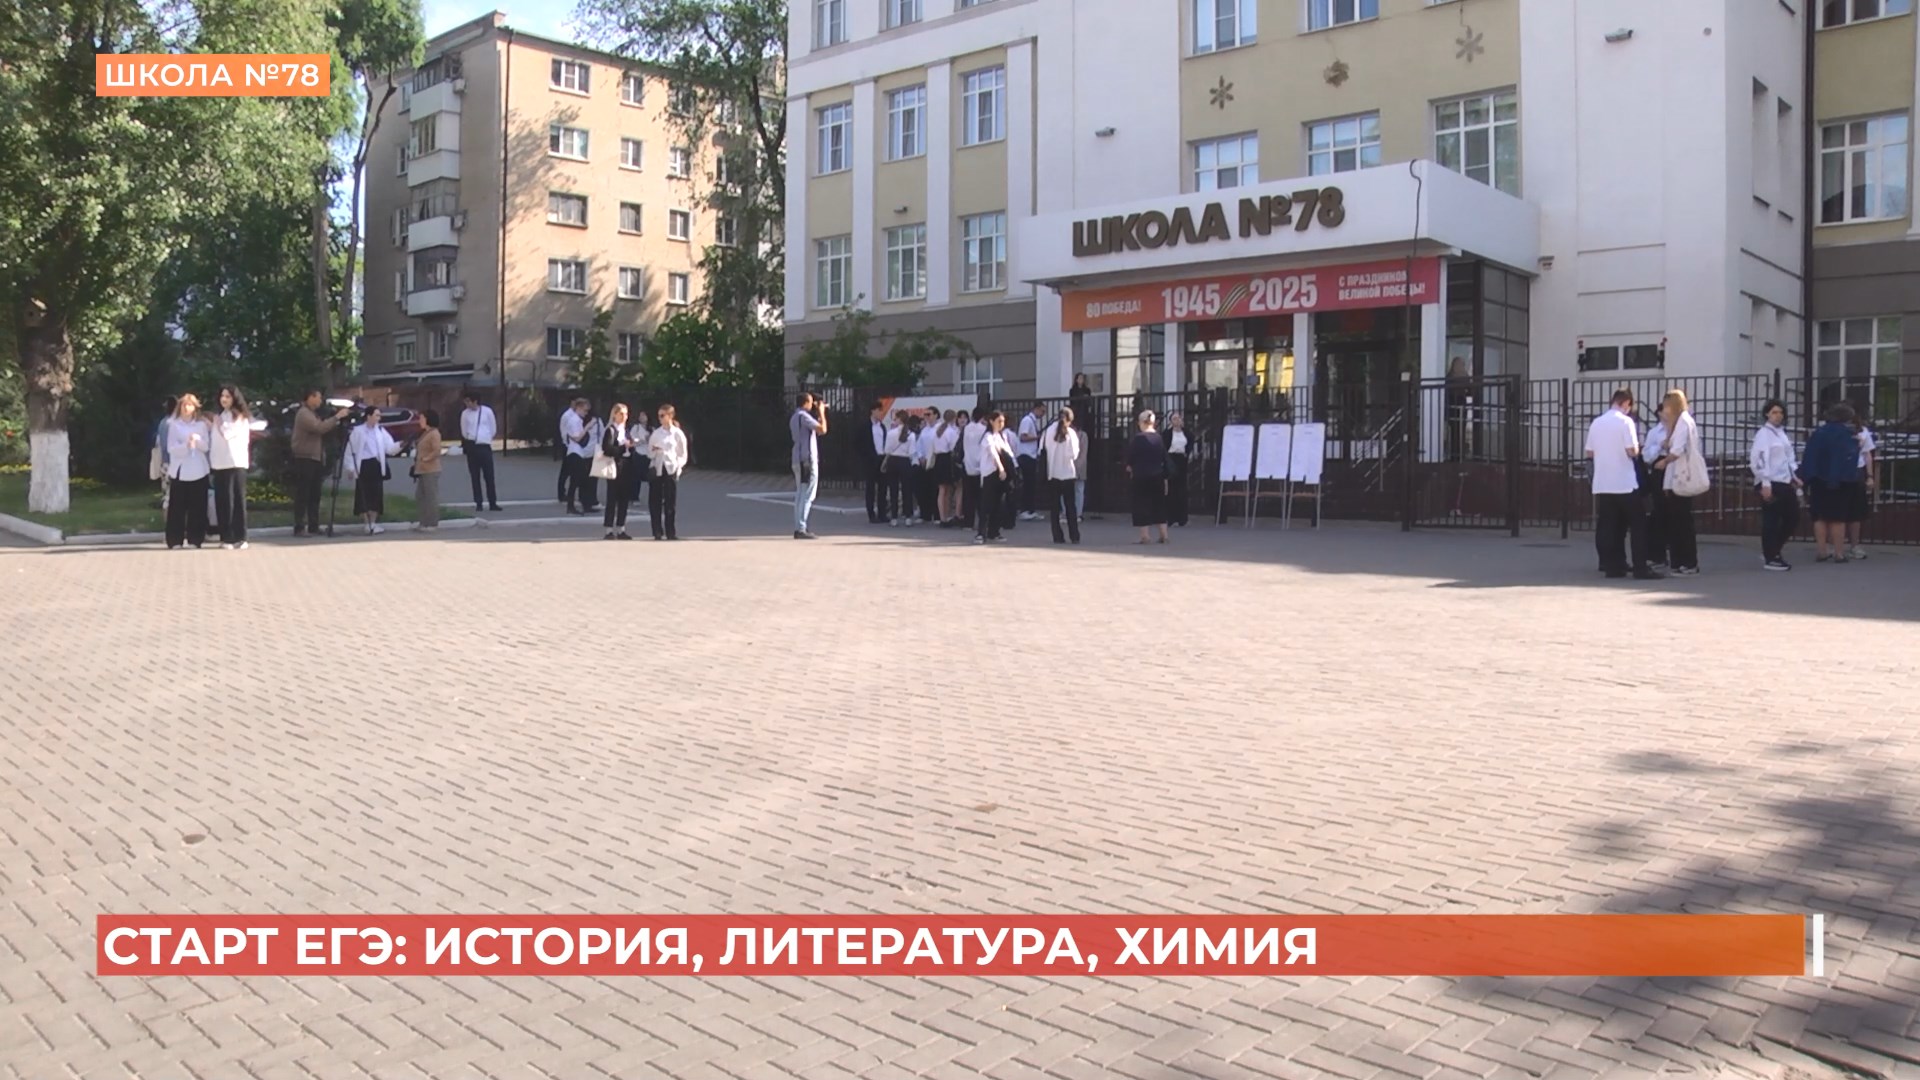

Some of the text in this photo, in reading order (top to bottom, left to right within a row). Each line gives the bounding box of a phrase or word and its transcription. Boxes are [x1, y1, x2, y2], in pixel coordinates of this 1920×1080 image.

[1072, 186, 1346, 258] ШКОЛА №78
[1338, 275, 1346, 288] С
[1161, 274, 1318, 319] 1945 2025
[1338, 285, 1381, 301] ВЕЛИКОЙ
[1086, 299, 1142, 318] 80 ПОБЕДА!
